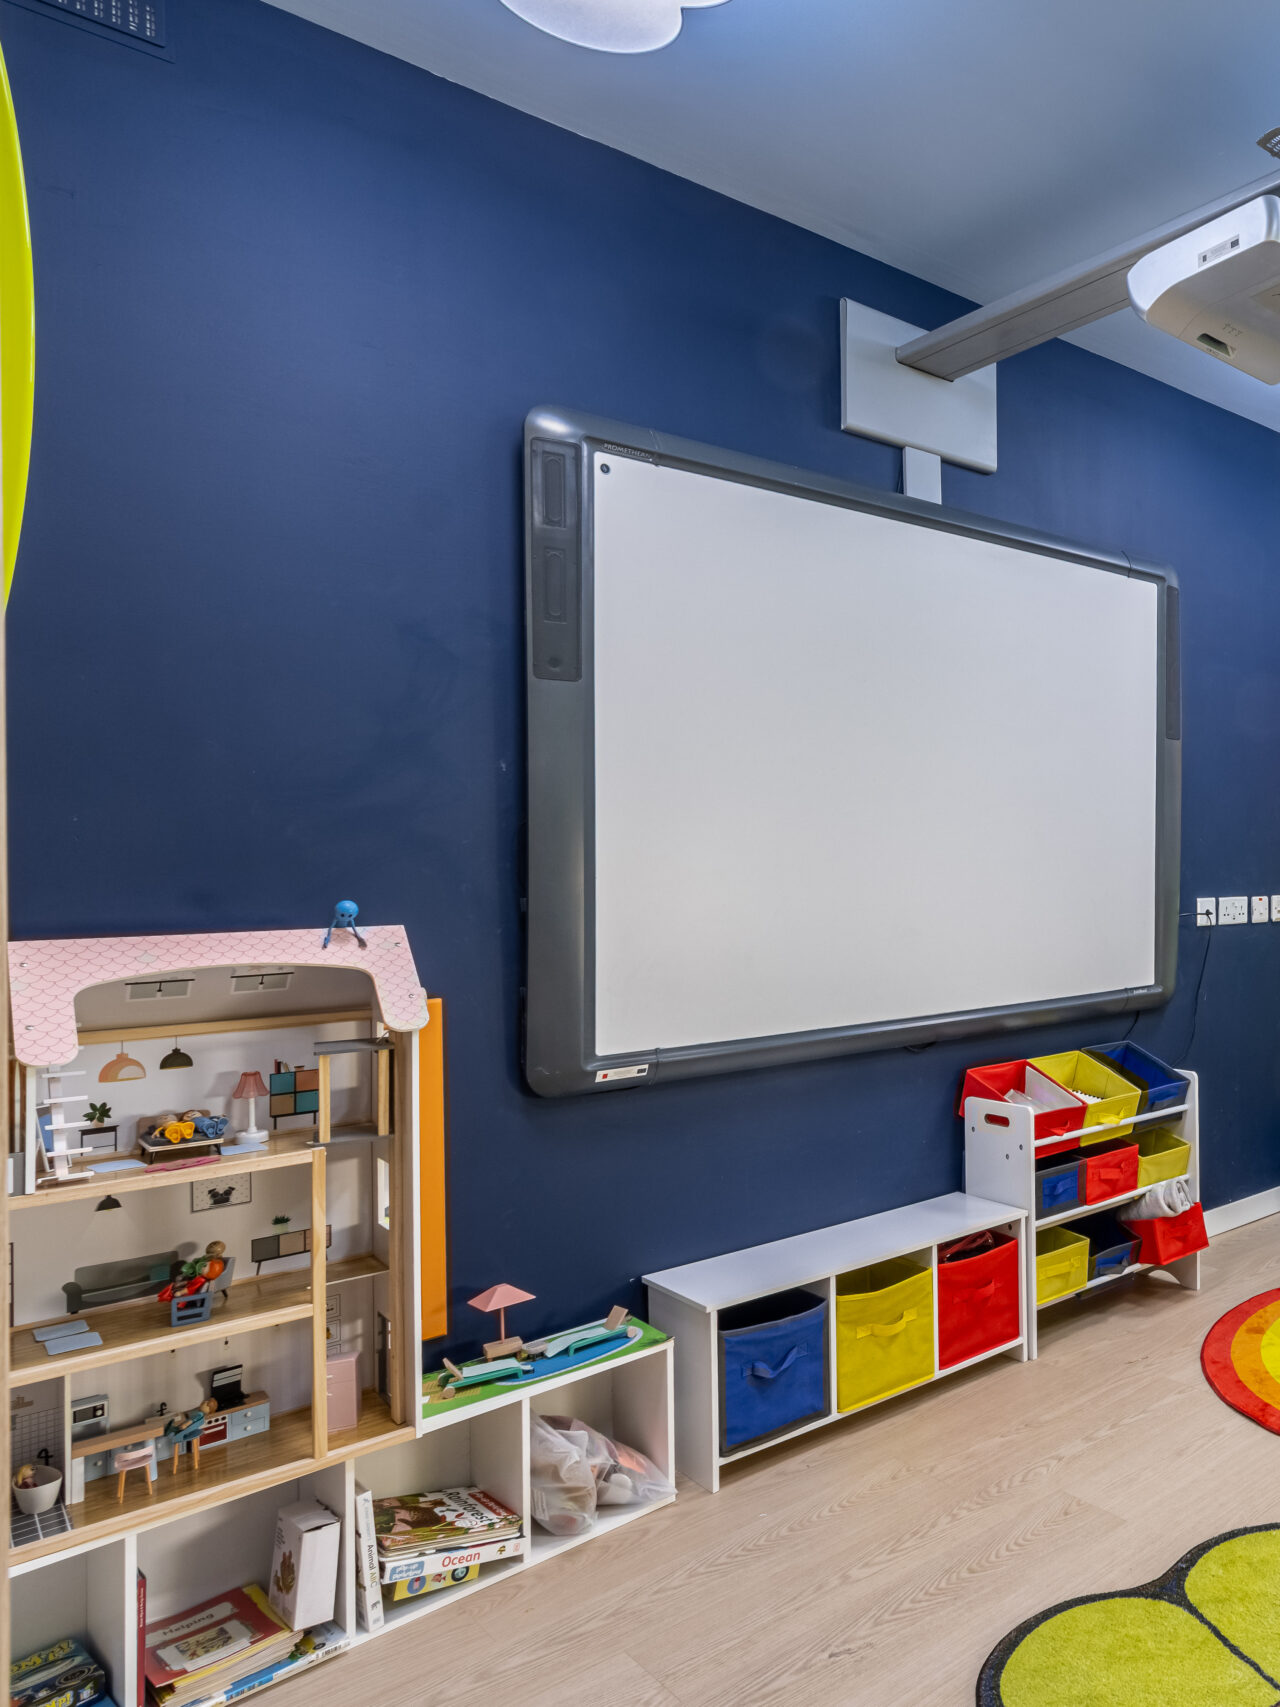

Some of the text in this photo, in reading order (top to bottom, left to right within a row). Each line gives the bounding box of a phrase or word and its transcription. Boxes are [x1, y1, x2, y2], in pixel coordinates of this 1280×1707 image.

[367, 1544, 376, 1571] Animal
[441, 1552, 480, 1568] Ocean
[162, 1613, 215, 1636] Helping
